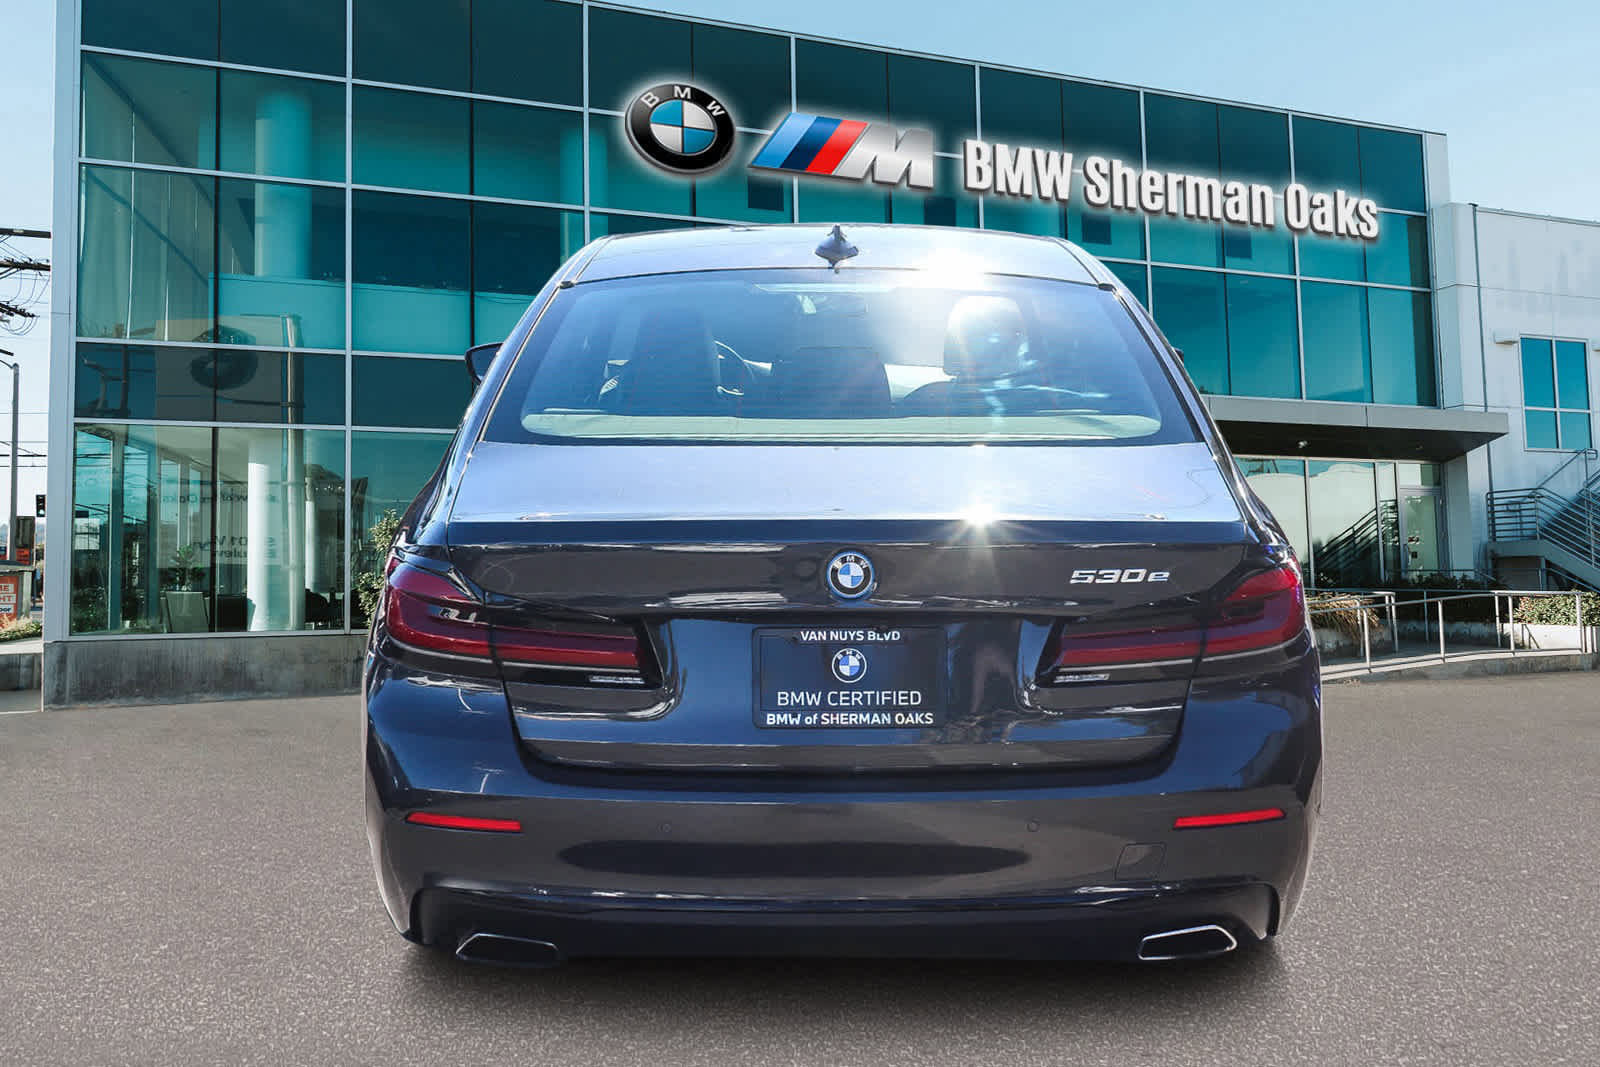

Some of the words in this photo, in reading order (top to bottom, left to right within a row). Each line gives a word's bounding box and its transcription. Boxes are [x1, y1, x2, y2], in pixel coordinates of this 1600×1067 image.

[963, 138, 1074, 201] BMW
[1083, 155, 1275, 228] Sherman
[1284, 183, 1380, 241] Oaks
[1069, 568, 1171, 584] 530e
[800, 630, 827, 641] VAN
[829, 630, 865, 641] NUYS
[867, 630, 901, 641] BLVD
[777, 691, 822, 706] BMW
[827, 691, 922, 706] CERTIFIED
[766, 713, 802, 725] BMW
[804, 713, 819, 725] of
[820, 713, 892, 725] SHERMAN
[894, 713, 934, 725] OAKS
